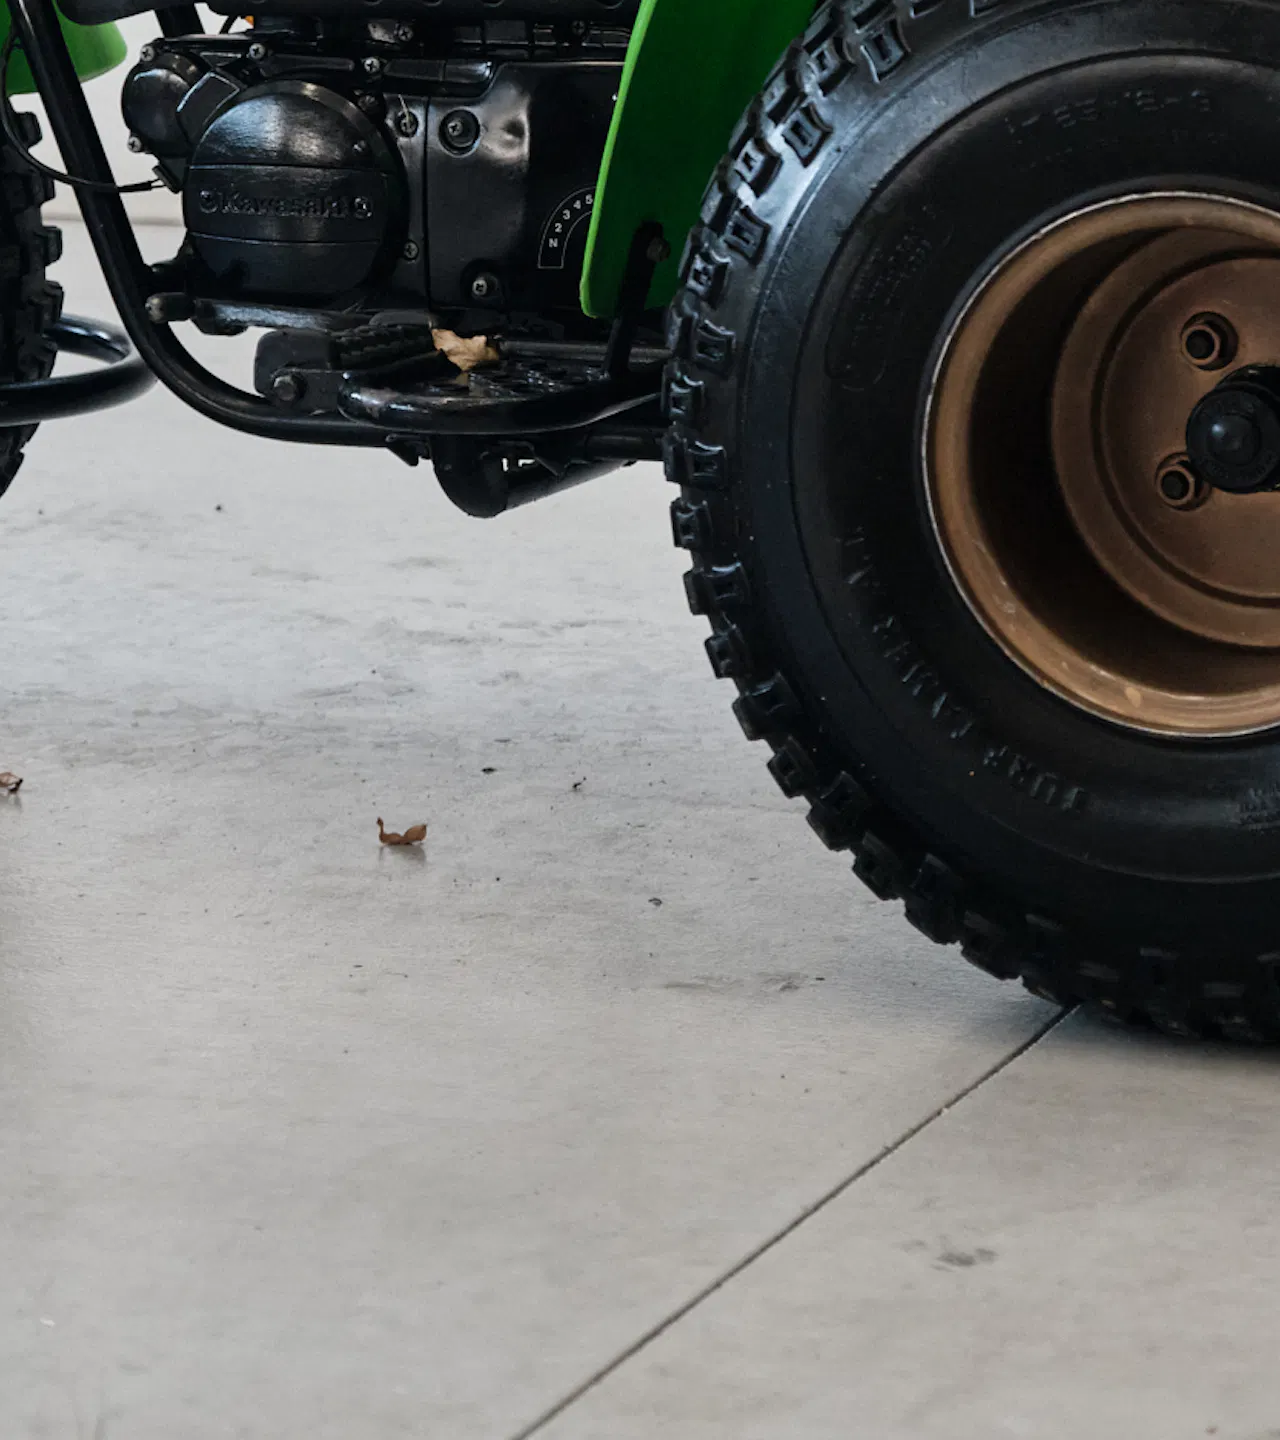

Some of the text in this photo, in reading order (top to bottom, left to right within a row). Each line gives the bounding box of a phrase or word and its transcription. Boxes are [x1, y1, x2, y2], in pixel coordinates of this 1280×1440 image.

[221, 191, 347, 218] Kawasaki
[548, 238, 558, 247] N
[554, 222, 562, 233] 2
[562, 209, 571, 220] 3
[573, 199, 581, 210] 4
